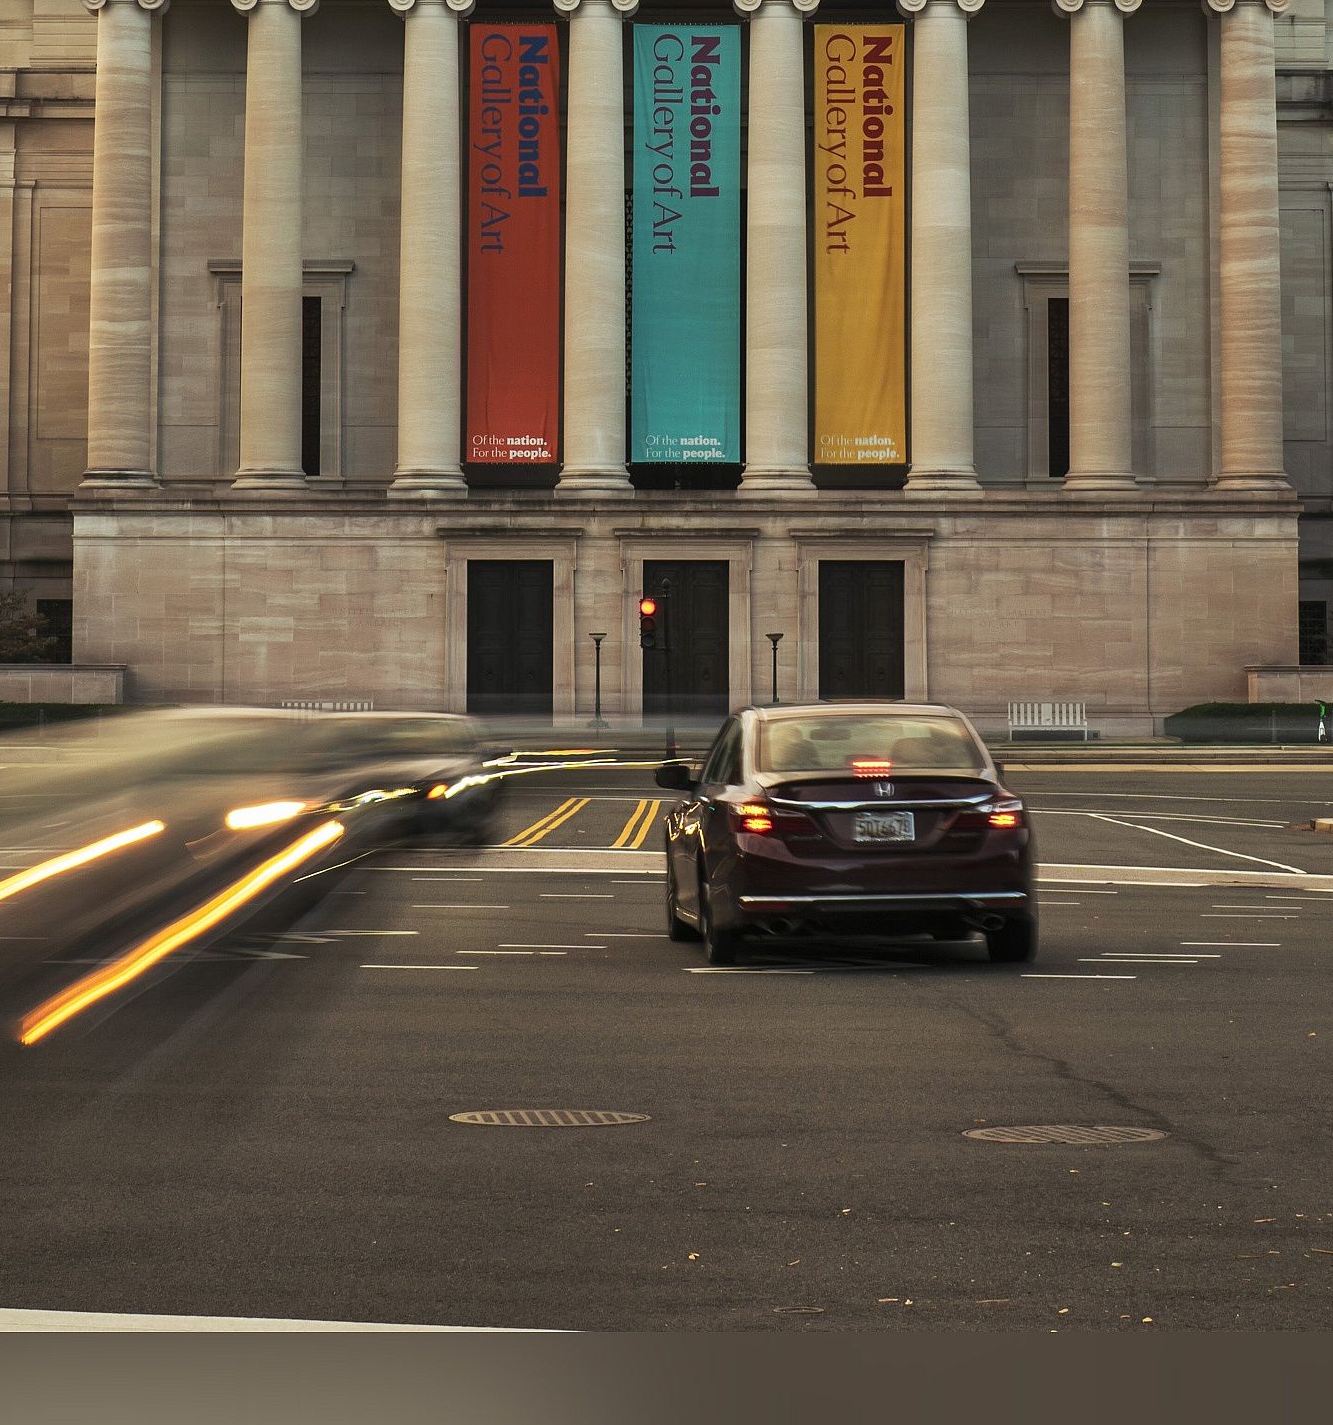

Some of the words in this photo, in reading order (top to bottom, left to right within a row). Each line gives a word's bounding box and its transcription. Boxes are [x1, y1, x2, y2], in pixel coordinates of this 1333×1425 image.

[473, 33, 512, 159] Gallery
[518, 35, 549, 198] National
[645, 33, 684, 160] Gallery
[689, 35, 721, 198] National
[818, 33, 856, 161] Gallery
[862, 35, 894, 198] National
[480, 162, 511, 200] of
[652, 162, 683, 200] of
[825, 162, 856, 200] of
[480, 201, 512, 255] Art
[652, 200, 683, 255] Art
[826, 200, 856, 255] Art
[472, 434, 488, 446] Of
[489, 434, 505, 445] the
[506, 434, 548, 446] nation.
[472, 447, 489, 458] For
[491, 446, 508, 458] the
[509, 447, 552, 460] people.
[645, 434, 661, 446] Of
[662, 434, 678, 446] the
[680, 434, 722, 446] nation.
[645, 447, 664, 458] For
[665, 446, 681, 458] the
[682, 447, 726, 460] people.
[820, 434, 835, 446] Of
[836, 434, 853, 446] the
[854, 434, 896, 446] nation.
[820, 447, 837, 459] For
[839, 446, 855, 459] the
[856, 447, 900, 461] people.
